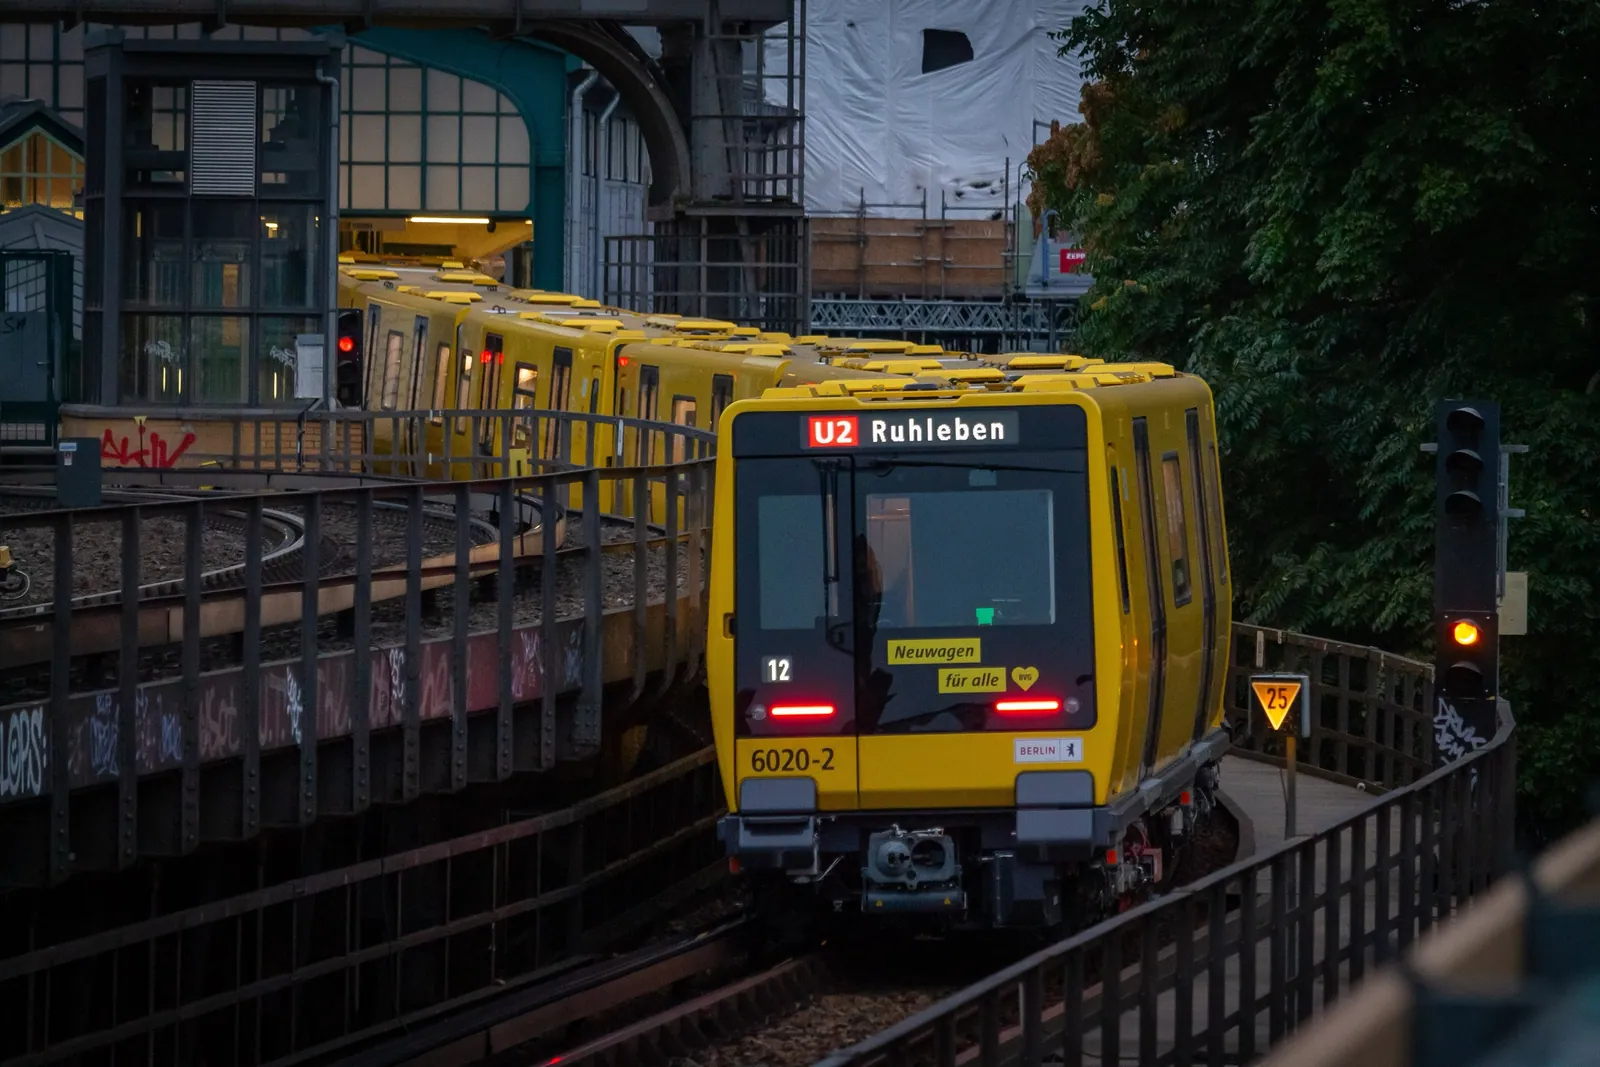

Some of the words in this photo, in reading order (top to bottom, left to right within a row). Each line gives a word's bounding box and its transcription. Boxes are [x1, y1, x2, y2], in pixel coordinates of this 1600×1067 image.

[814, 420, 853, 444] U2
[872, 417, 1004, 443] Ruhleben
[894, 645, 975, 661] Neuwagen
[768, 659, 790, 681] 12
[1018, 674, 1032, 682] BVG
[945, 673, 968, 688] für
[971, 673, 999, 687] alle
[1267, 687, 1288, 710] 25
[751, 748, 835, 772] 6020-2
[1020, 746, 1056, 756] BERLIN
